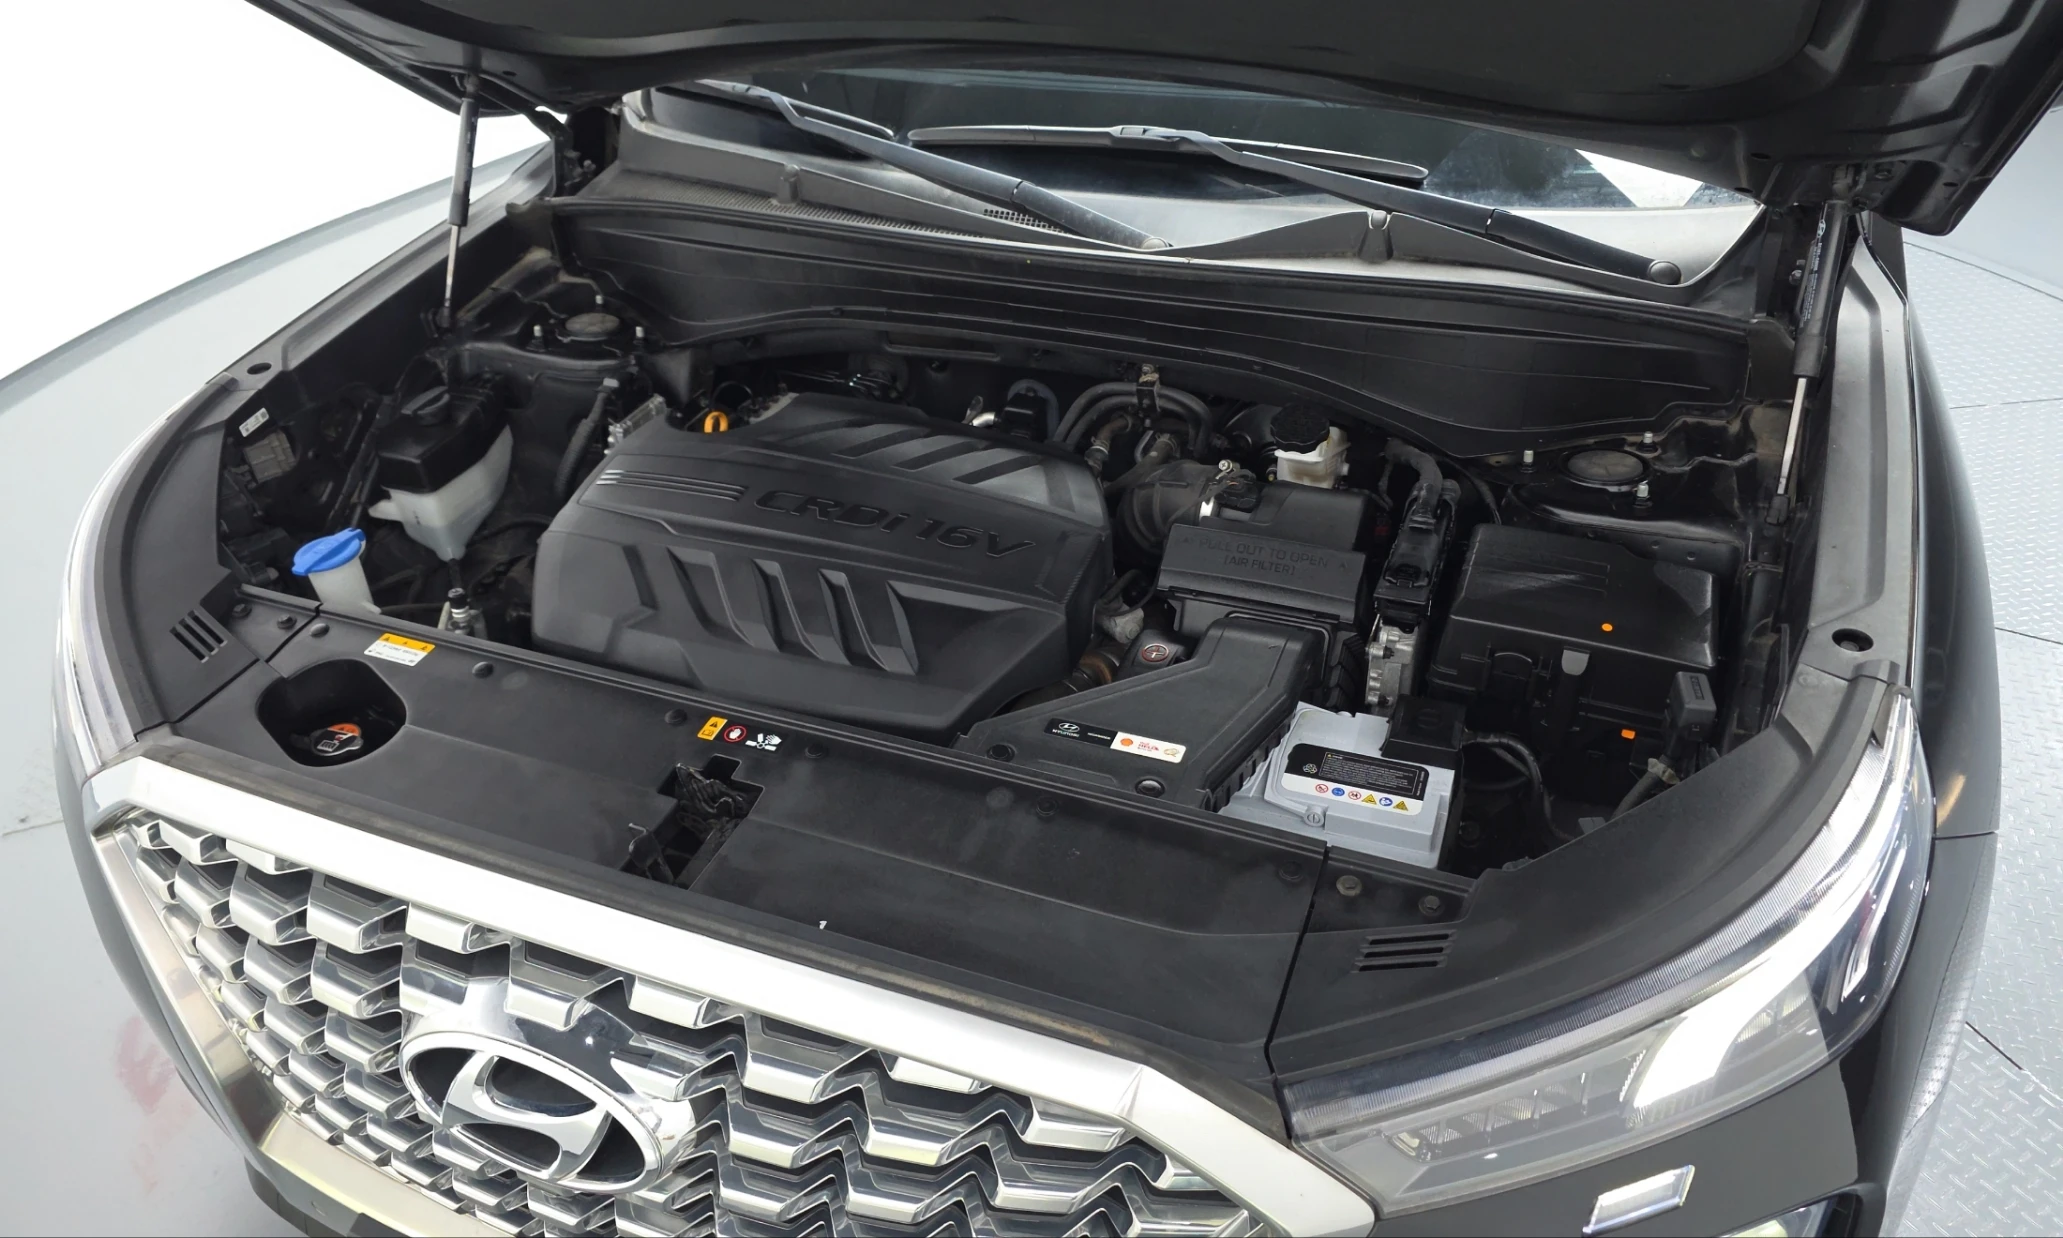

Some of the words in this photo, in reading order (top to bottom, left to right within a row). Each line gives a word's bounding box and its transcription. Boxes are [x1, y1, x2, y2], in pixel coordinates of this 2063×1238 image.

[916, 518, 1036, 558] 16V
[1199, 537, 1232, 551] PULL
[1236, 543, 1264, 556] OUT
[1269, 548, 1287, 561] TO
[1290, 551, 1329, 568] OPEN
